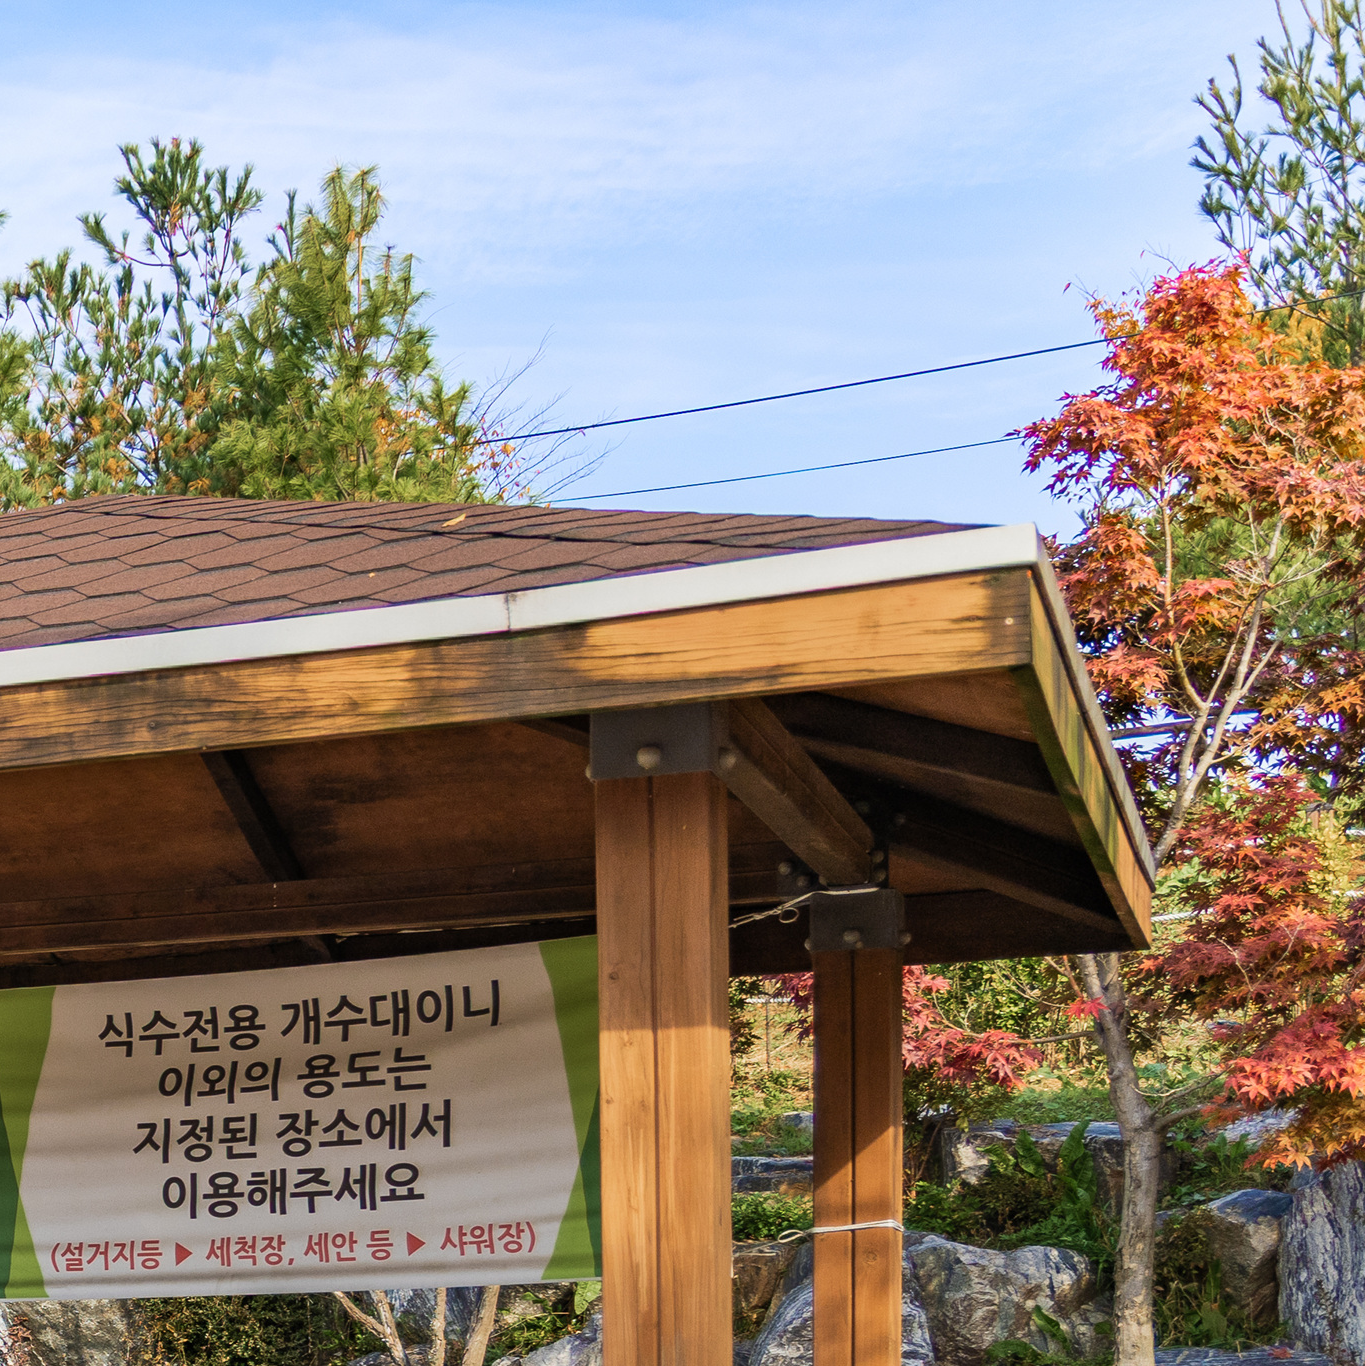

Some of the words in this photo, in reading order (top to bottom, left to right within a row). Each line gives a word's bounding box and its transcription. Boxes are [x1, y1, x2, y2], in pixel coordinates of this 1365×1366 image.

[98, 1004, 266, 1057] 식수전용
[280, 979, 500, 1045] 개수대이니
[158, 1056, 282, 1107] 이외의
[297, 1047, 431, 1099] 용도는
[133, 1112, 258, 1164] 지정된
[276, 1098, 451, 1157] 장소에서
[162, 1162, 425, 1219] 이용해주세요
[50, 1240, 163, 1273] (설거지등
[205, 1234, 295, 1268] 세척장,
[303, 1231, 358, 1263] 세안
[366, 1229, 394, 1261] 등
[440, 1221, 537, 1257] 샤워장)
